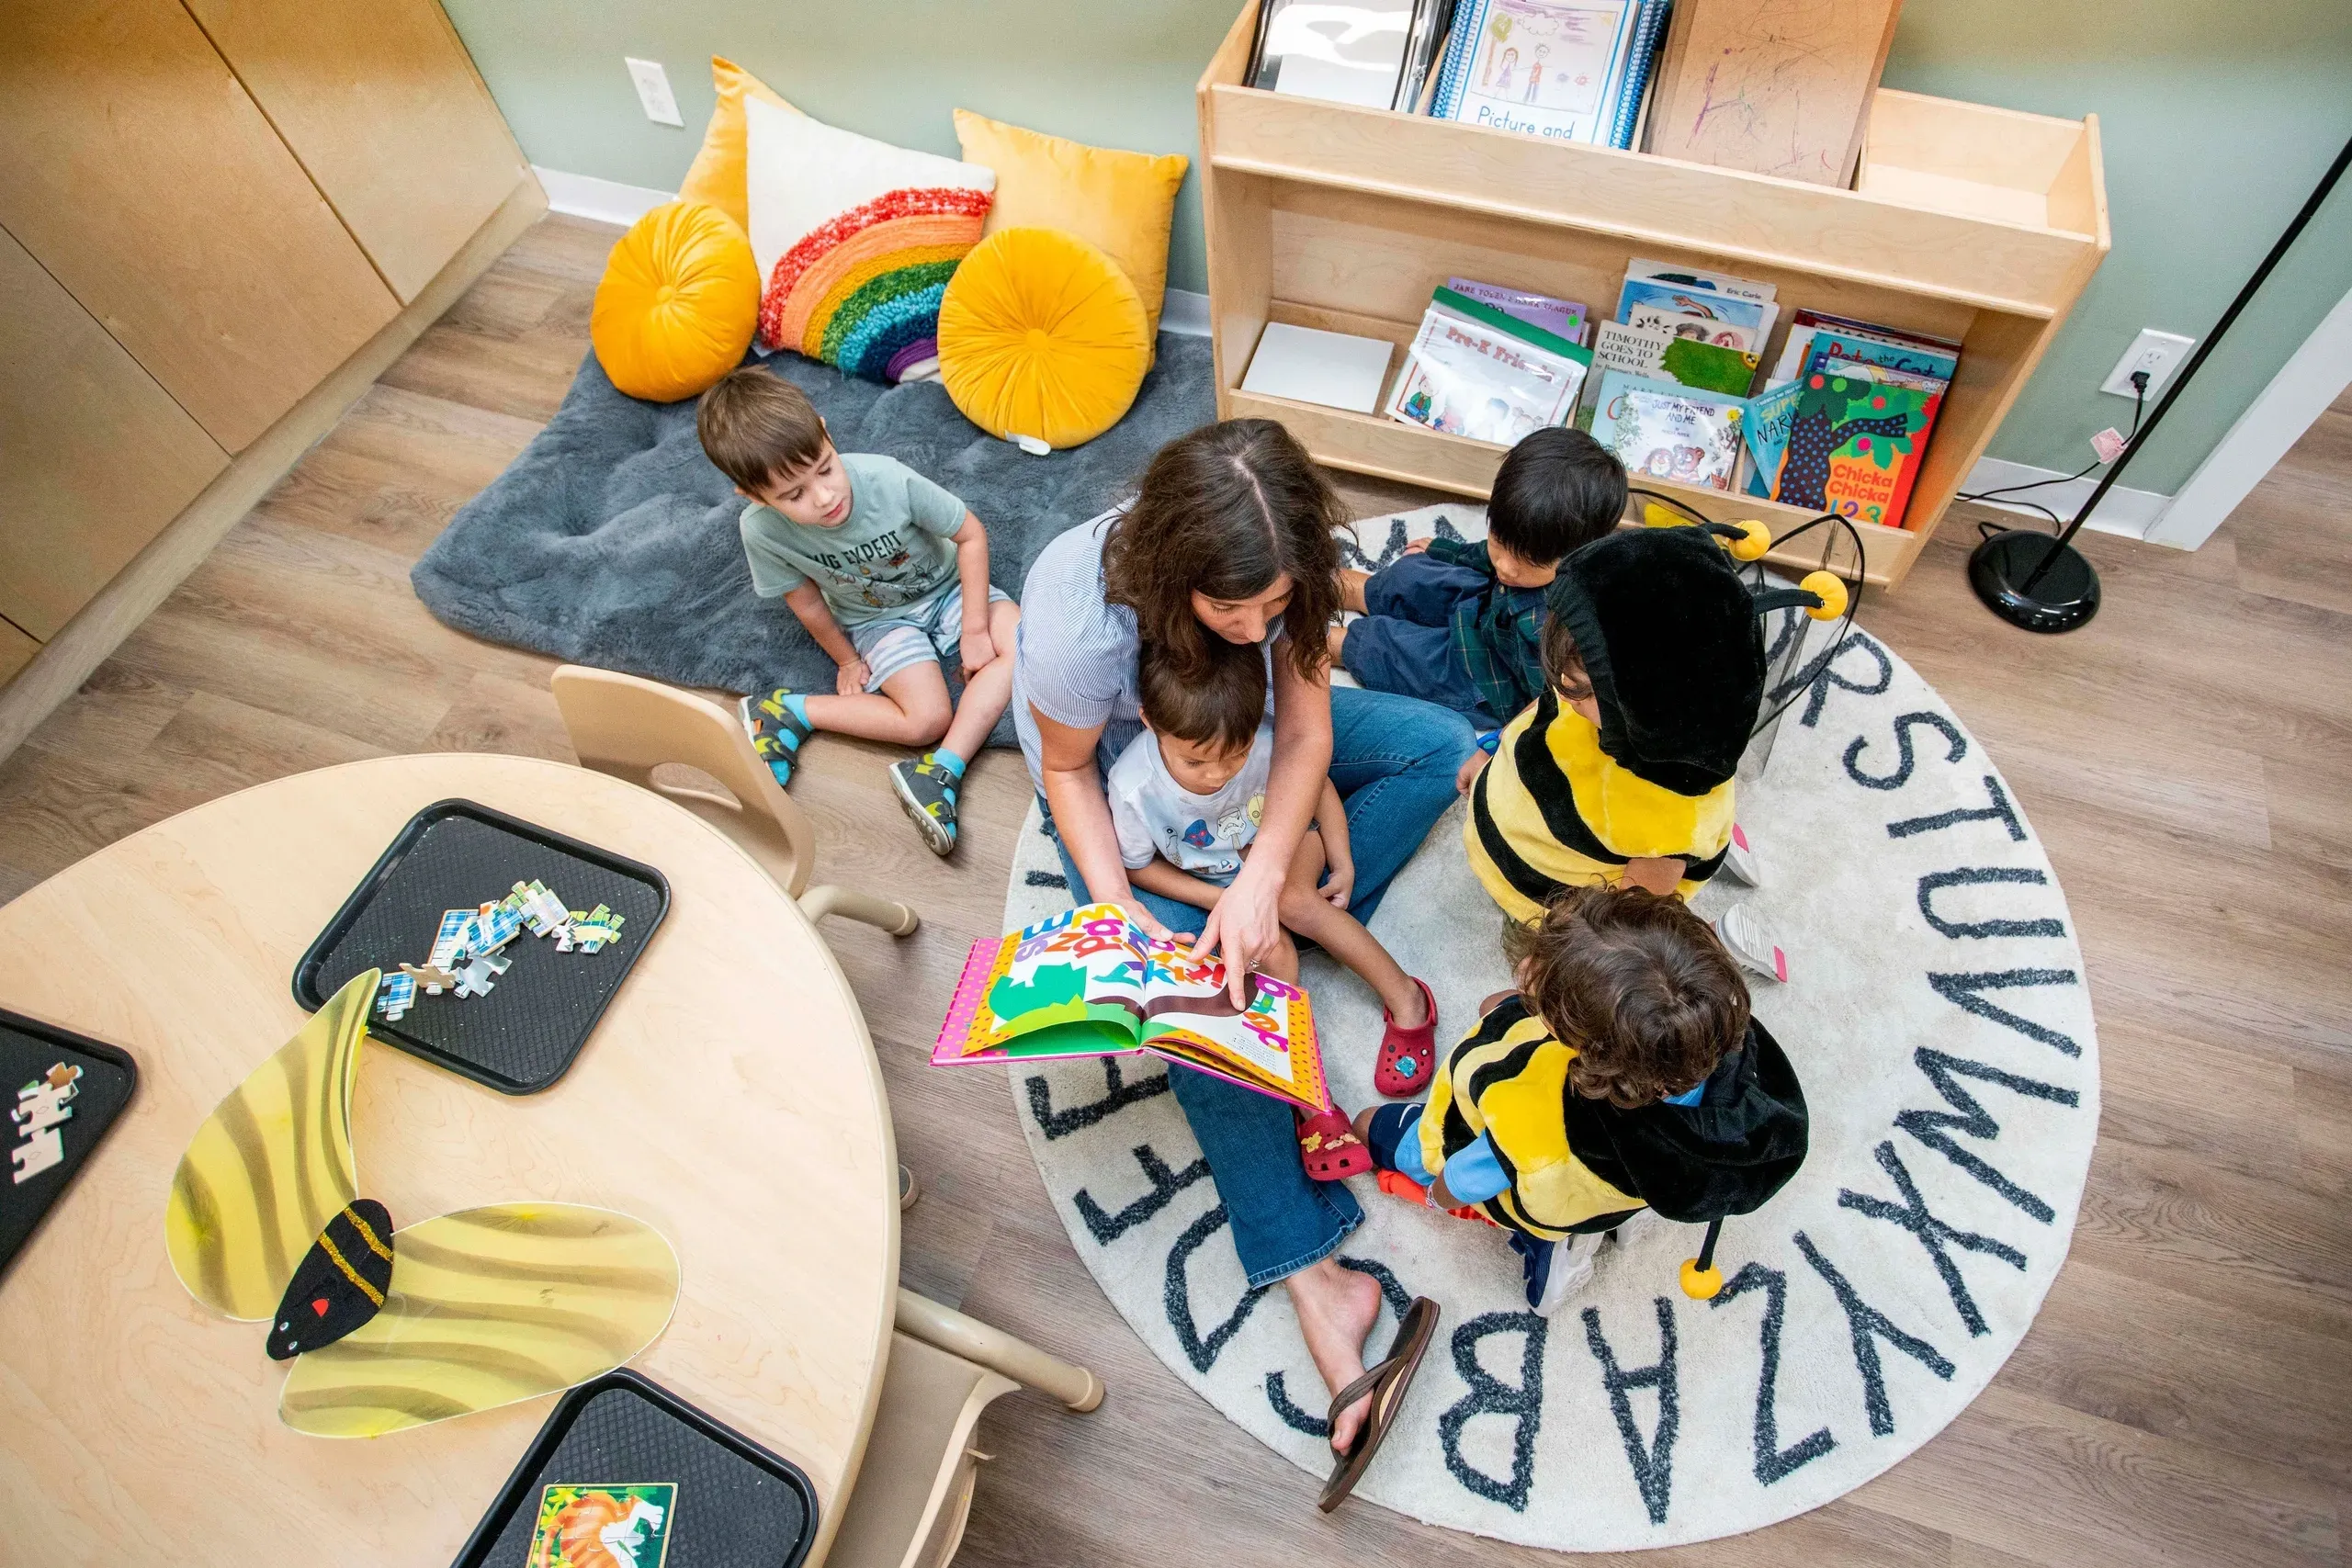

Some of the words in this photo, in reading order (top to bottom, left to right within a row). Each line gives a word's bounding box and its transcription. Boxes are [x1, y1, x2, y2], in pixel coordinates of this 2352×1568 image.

[1476, 105, 1535, 134] Picture
[1543, 121, 1575, 140] and
[1453, 284, 1475, 294] JANE
[1726, 287, 1740, 295] Eric
[1742, 290, 1761, 299] Carle
[1445, 325, 1491, 355] Pre-K
[1492, 345, 1555, 383] Fries
[1598, 351, 1648, 368] SCHOOL
[1600, 340, 1634, 355] GOES
[1636, 348, 1654, 358] TO
[1604, 330, 1661, 350] TIMOTHY
[1879, 354, 1895, 363] the
[1652, 399, 1670, 410] JUST
[1672, 403, 1685, 412] MY
[1665, 412, 1682, 422] AND
[1683, 414, 1697, 424] ME
[1829, 480, 1889, 504] Chicka
[1833, 464, 1893, 488] Chicka
[806, 553, 842, 570] UG
[842, 530, 901, 566] EXPERT
[1841, 711, 1966, 791] S
[1886, 774, 2027, 842] T
[1917, 866, 2066, 939] U
[1926, 968, 2082, 1058] V
[1892, 1045, 2080, 1227] W
[1838, 1140, 2027, 1338] X
[1792, 1230, 1956, 1438] Y
[1708, 1262, 1838, 1486] Z
[1438, 1310, 1548, 1514] B
[1581, 1296, 1679, 1525] A
